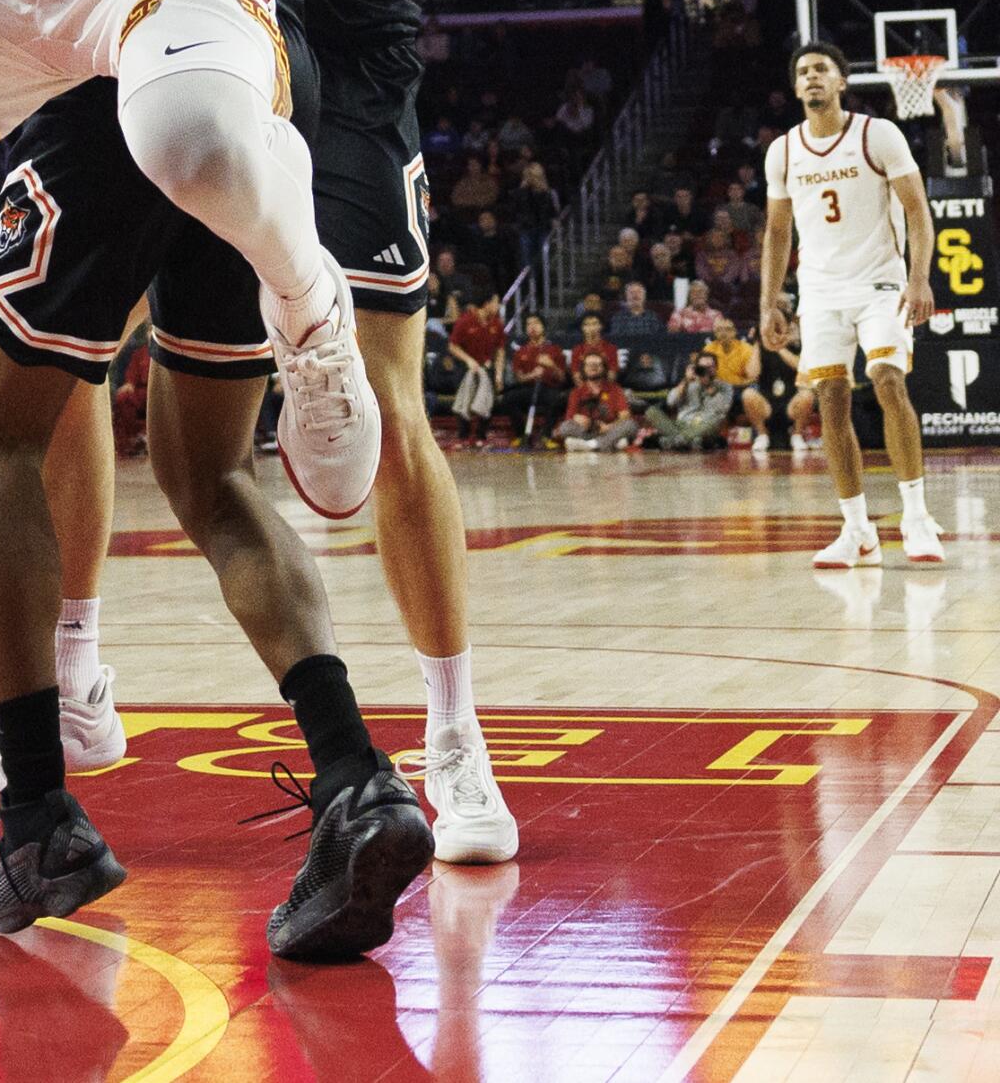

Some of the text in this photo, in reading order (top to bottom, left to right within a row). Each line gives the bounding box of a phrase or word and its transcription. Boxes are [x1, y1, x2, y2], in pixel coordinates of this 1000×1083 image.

[796, 166, 860, 187] TROJANS
[821, 188, 842, 224] 3
[930, 199, 985, 218] YETI
[937, 228, 984, 295] SC
[921, 412, 1000, 426] PECHANG
